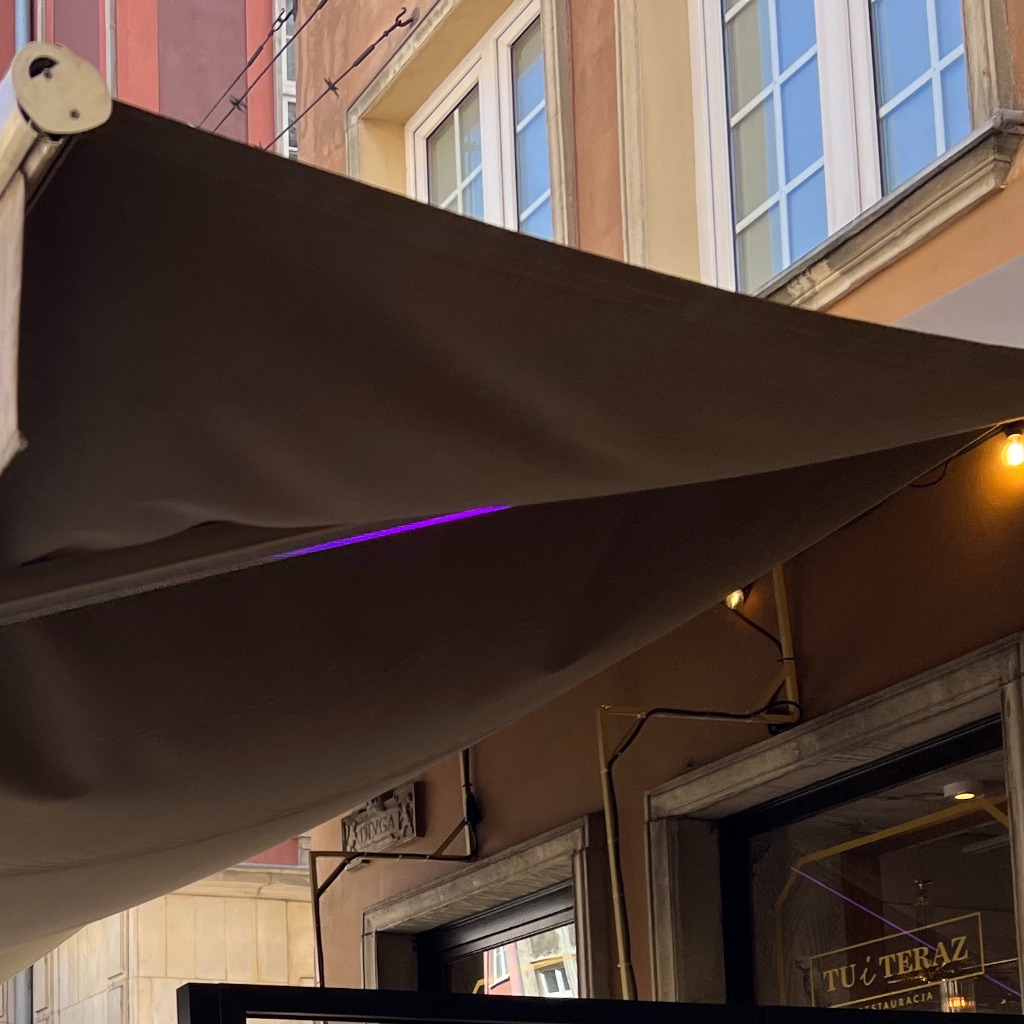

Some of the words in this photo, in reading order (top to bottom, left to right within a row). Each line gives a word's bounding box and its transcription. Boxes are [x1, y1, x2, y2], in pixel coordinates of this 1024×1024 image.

[822, 963, 857, 993] TU
[860, 955, 877, 987] i
[878, 935, 969, 979] TERAZ
